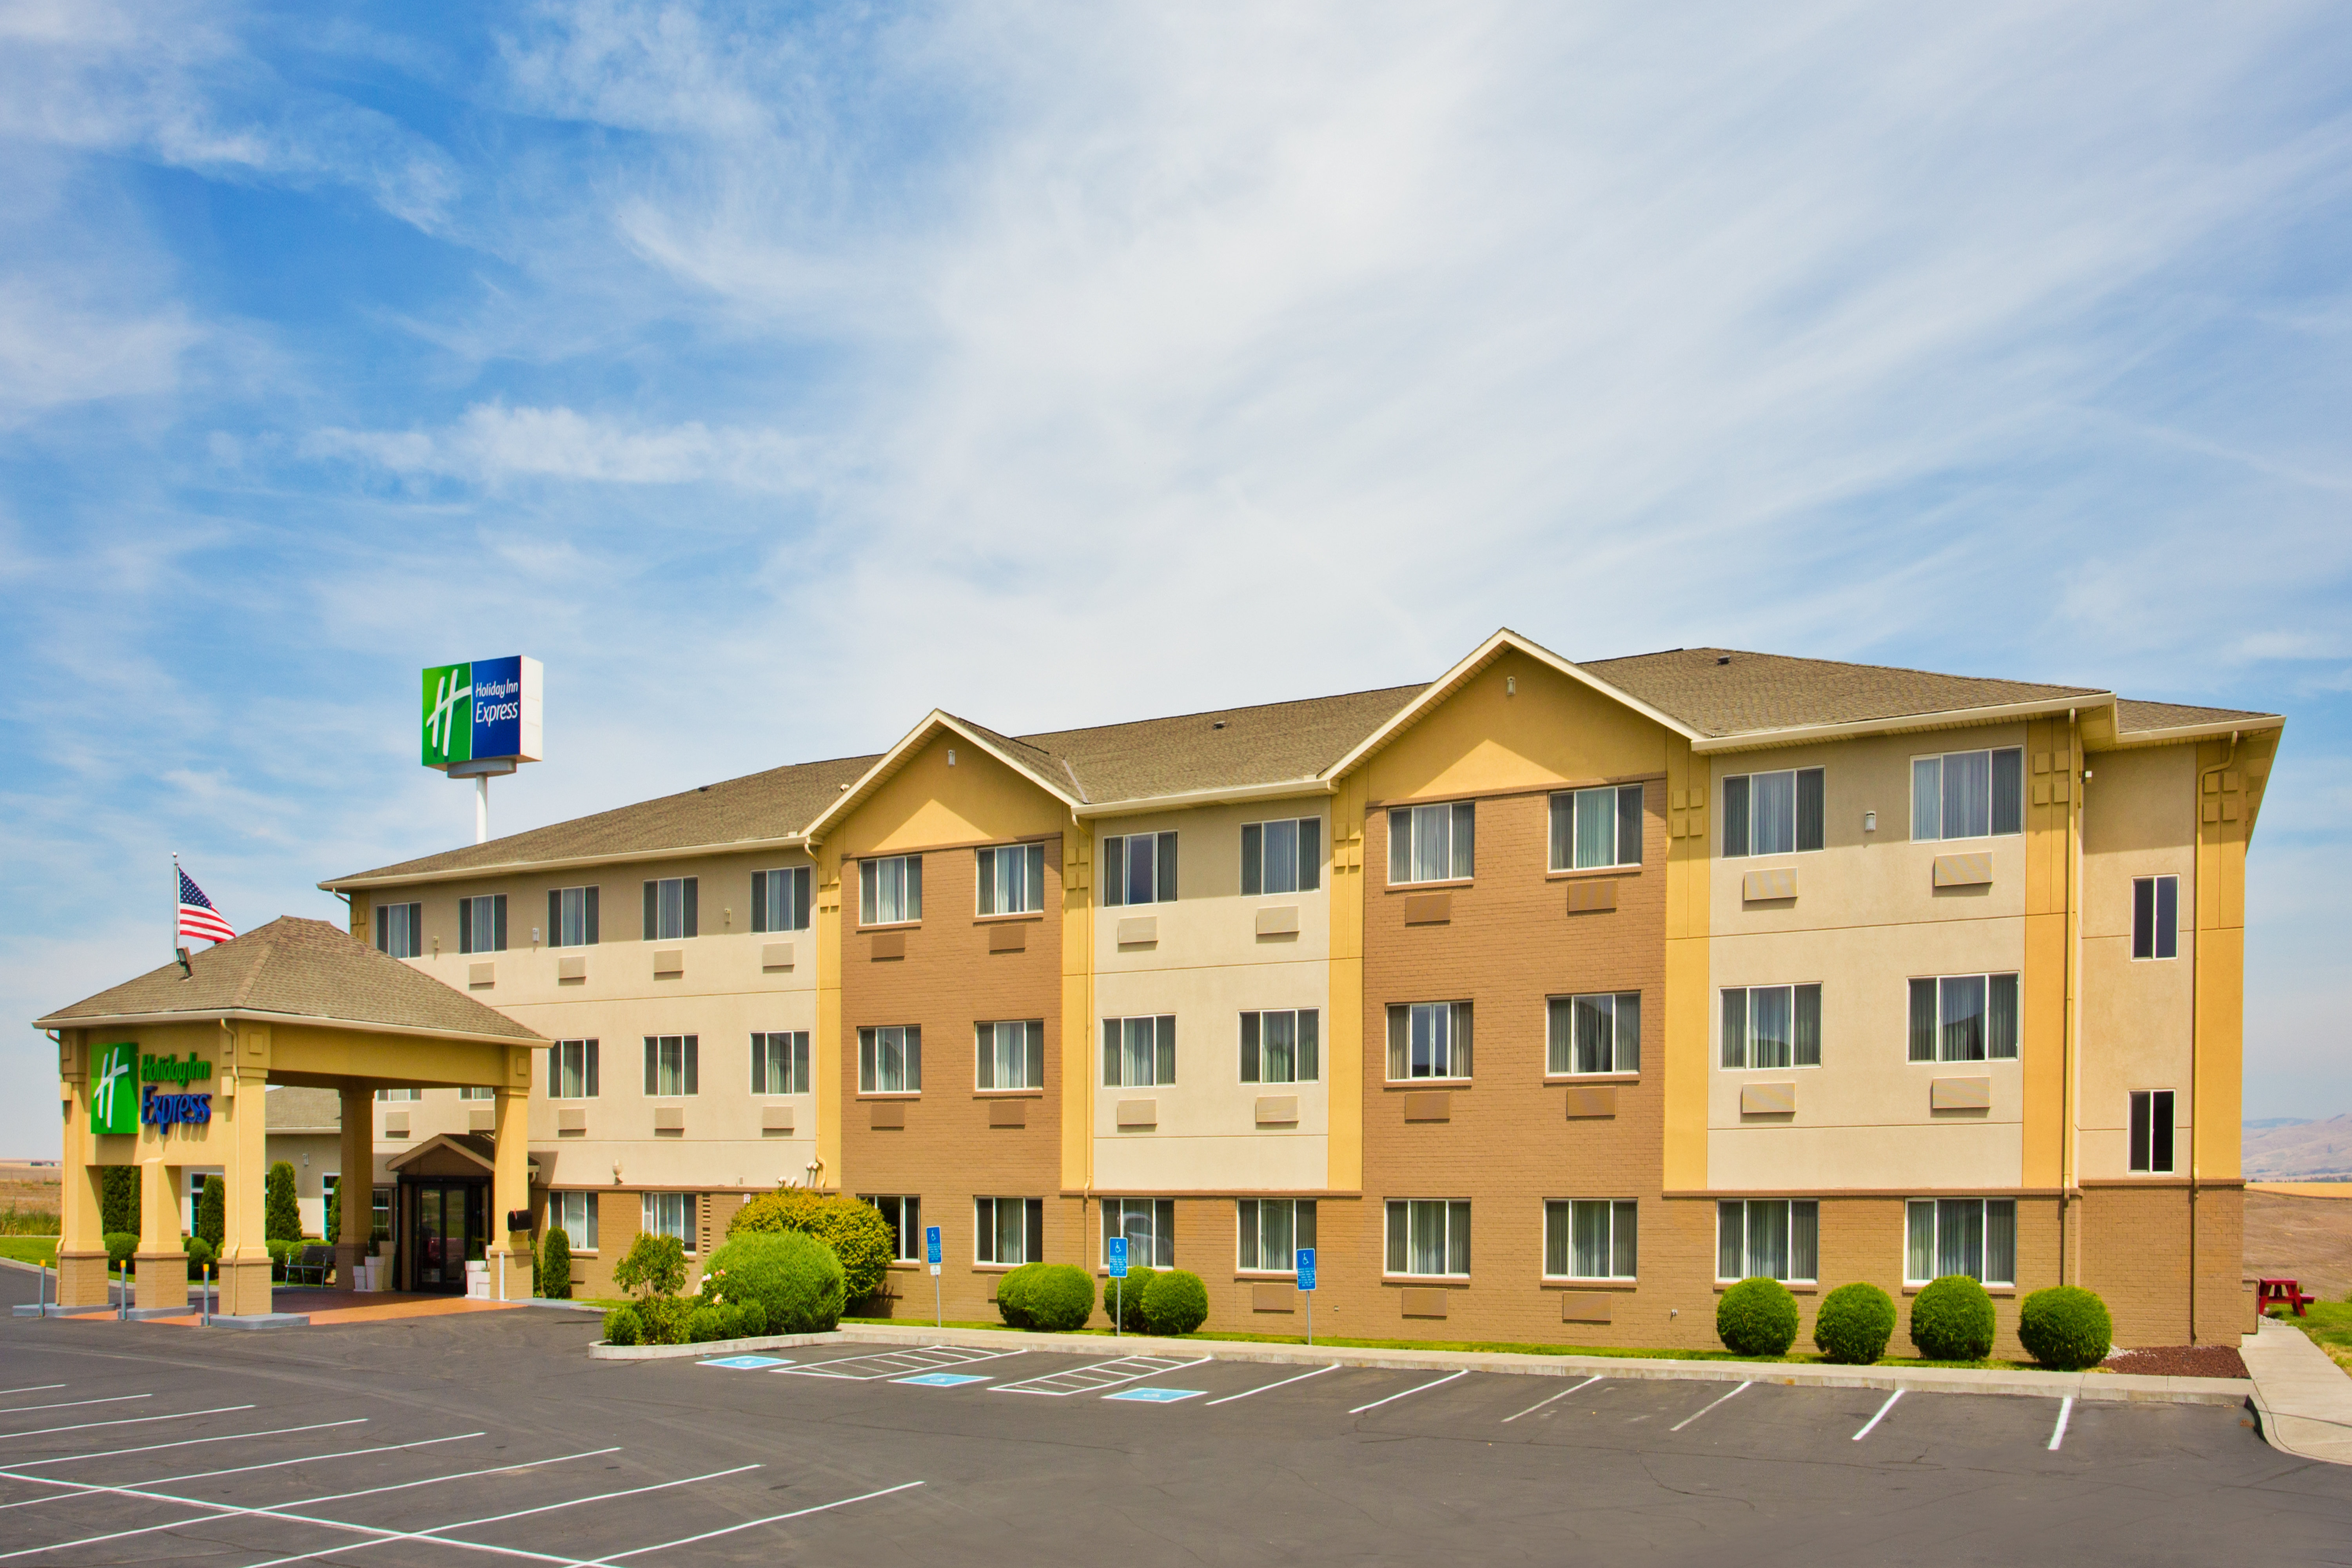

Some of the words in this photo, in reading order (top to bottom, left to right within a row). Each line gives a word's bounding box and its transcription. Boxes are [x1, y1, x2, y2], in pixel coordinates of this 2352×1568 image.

[475, 681, 505, 699] Holiday
[506, 678, 518, 694] Inn
[475, 701, 518, 727] Express
[141, 1053, 189, 1087] Holiday
[188, 1052, 212, 1079] Inn
[141, 1085, 212, 1135] Express
